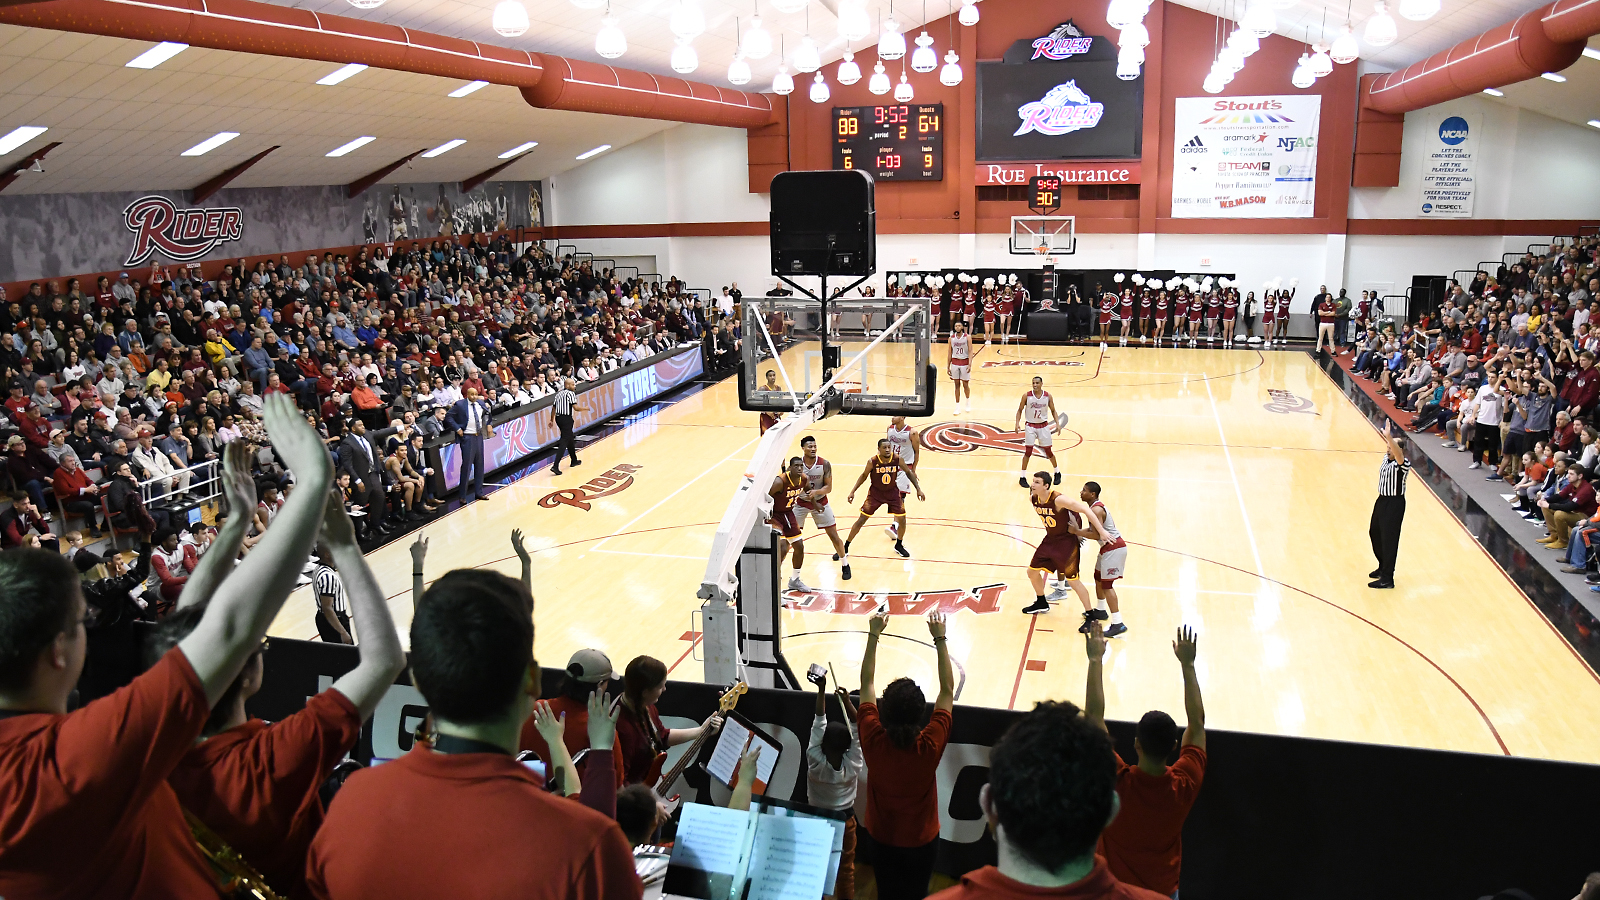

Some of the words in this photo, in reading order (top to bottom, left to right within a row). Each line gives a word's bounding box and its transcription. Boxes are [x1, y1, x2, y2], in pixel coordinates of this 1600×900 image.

[1031, 38, 1092, 60] RIDER
[1213, 100, 1282, 111] Stout's
[875, 106, 908, 123] 9:52
[1014, 102, 1103, 136] RIDER
[838, 118, 858, 134] 88
[918, 116, 938, 132] 64
[899, 126, 908, 139] 2
[1441, 130, 1467, 138] NCAA
[1276, 136, 1315, 152] NJAC
[844, 156, 852, 169] 6
[876, 156, 900, 168] 1-03
[924, 154, 932, 168] 9
[1228, 162, 1261, 170] TEAM
[1037, 179, 1058, 190] 9:52
[1036, 192, 1052, 206] 30
[123, 195, 243, 267] RIDER
[534, 382, 615, 446] UNERSITY
[620, 364, 658, 407] STORE
[1034, 410, 1042, 418] 12
[501, 416, 540, 462] R
[882, 474, 892, 484] 0
[537, 464, 644, 512] RIDER
